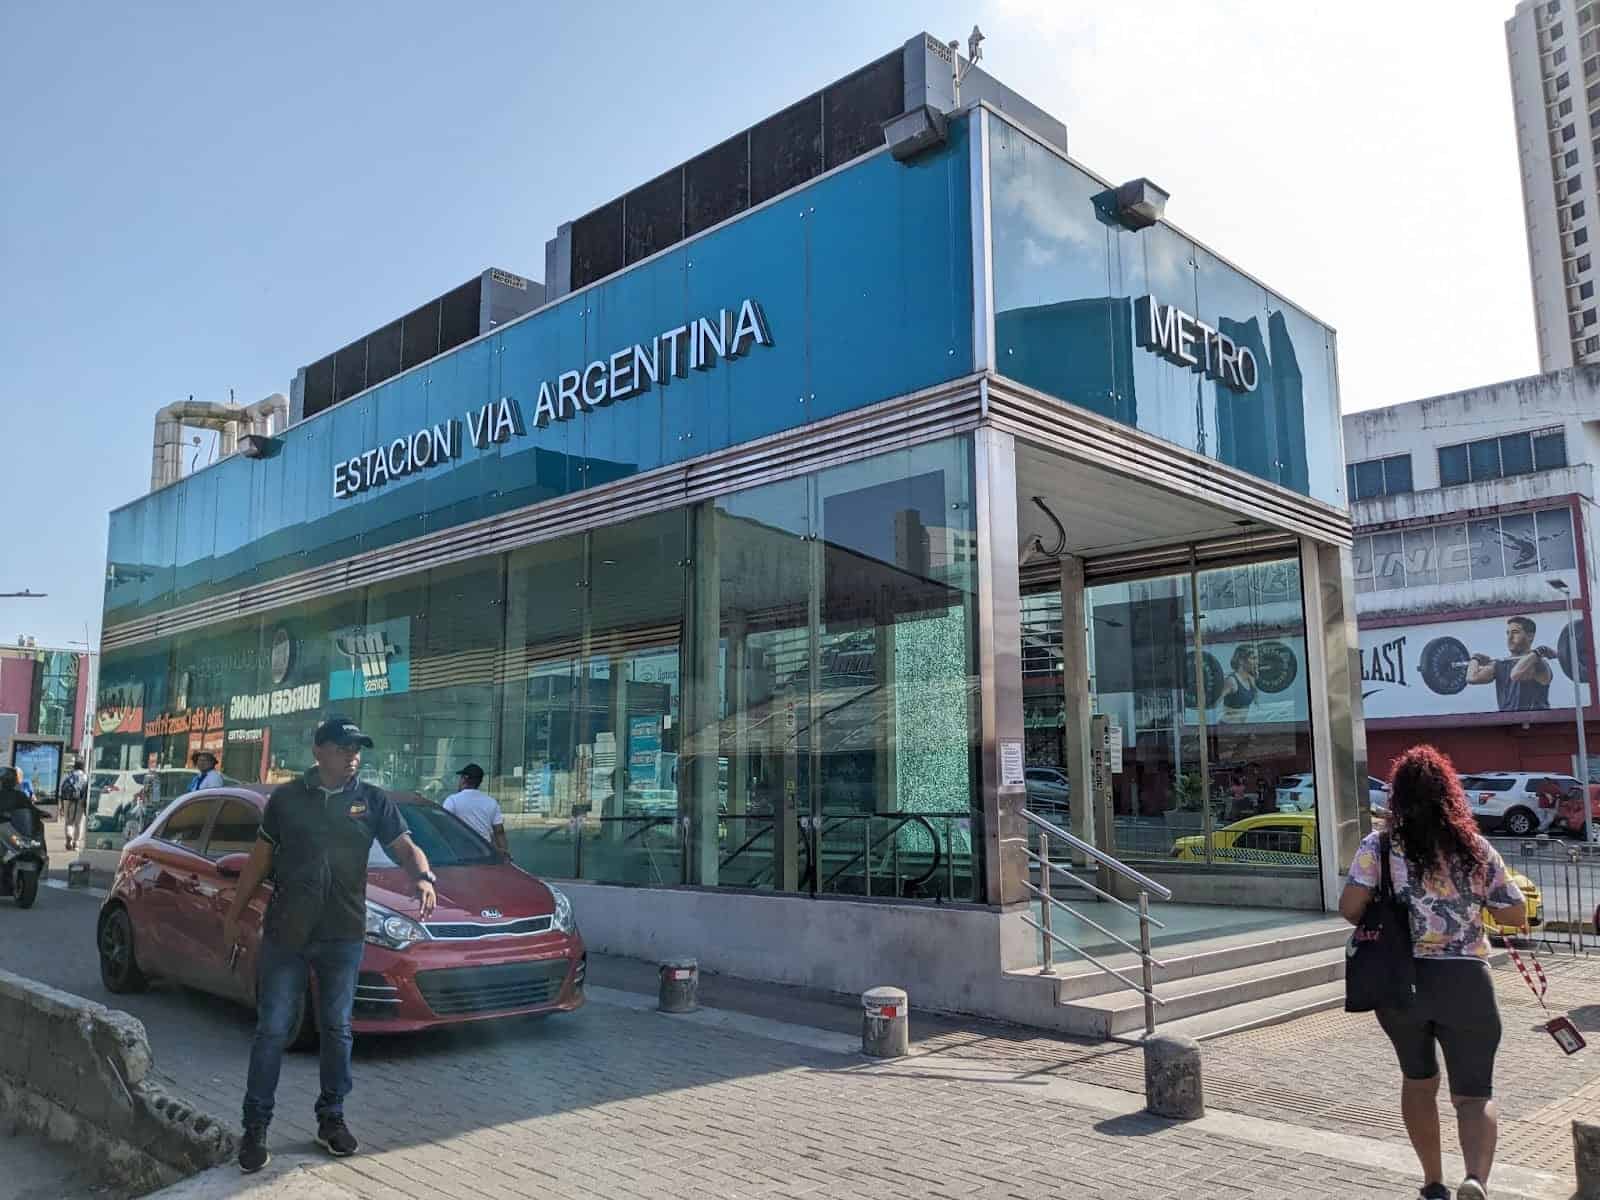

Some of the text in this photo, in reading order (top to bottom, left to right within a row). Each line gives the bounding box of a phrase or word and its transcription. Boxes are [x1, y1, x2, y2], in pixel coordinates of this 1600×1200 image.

[333, 298, 765, 499] ESTACION VIA ARGENTINA
[1149, 293, 1259, 392] METRO
